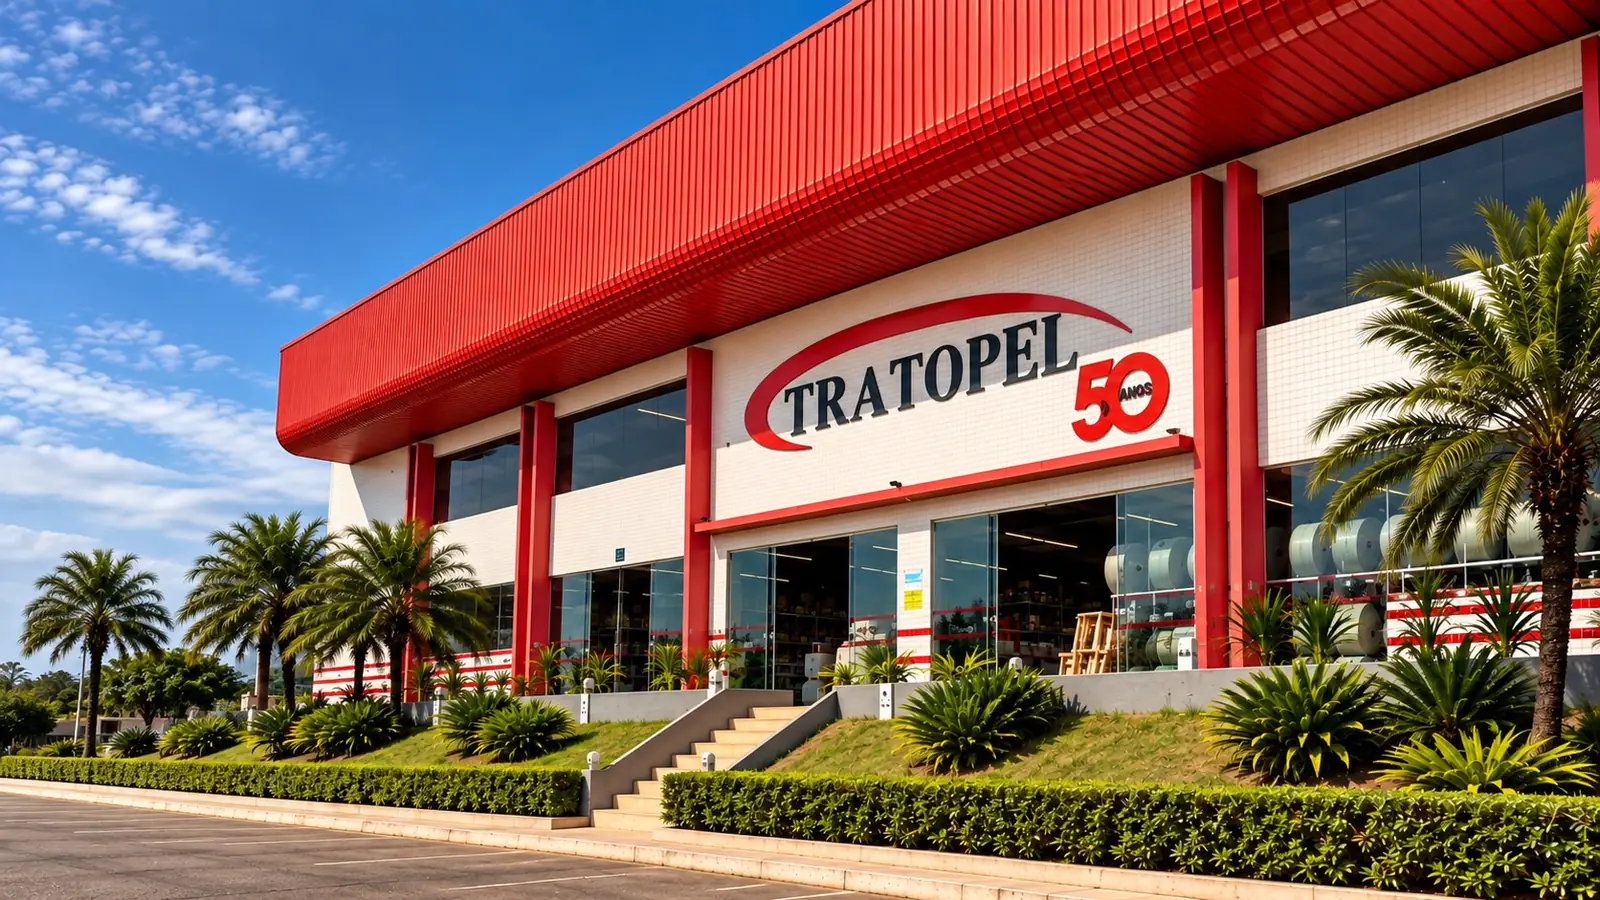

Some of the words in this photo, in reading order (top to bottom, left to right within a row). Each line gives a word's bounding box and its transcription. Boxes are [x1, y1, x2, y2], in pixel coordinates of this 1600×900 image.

[784, 312, 1078, 437] TRATOPEL
[1071, 351, 1170, 442] 50
[1119, 381, 1152, 402] ANOS
